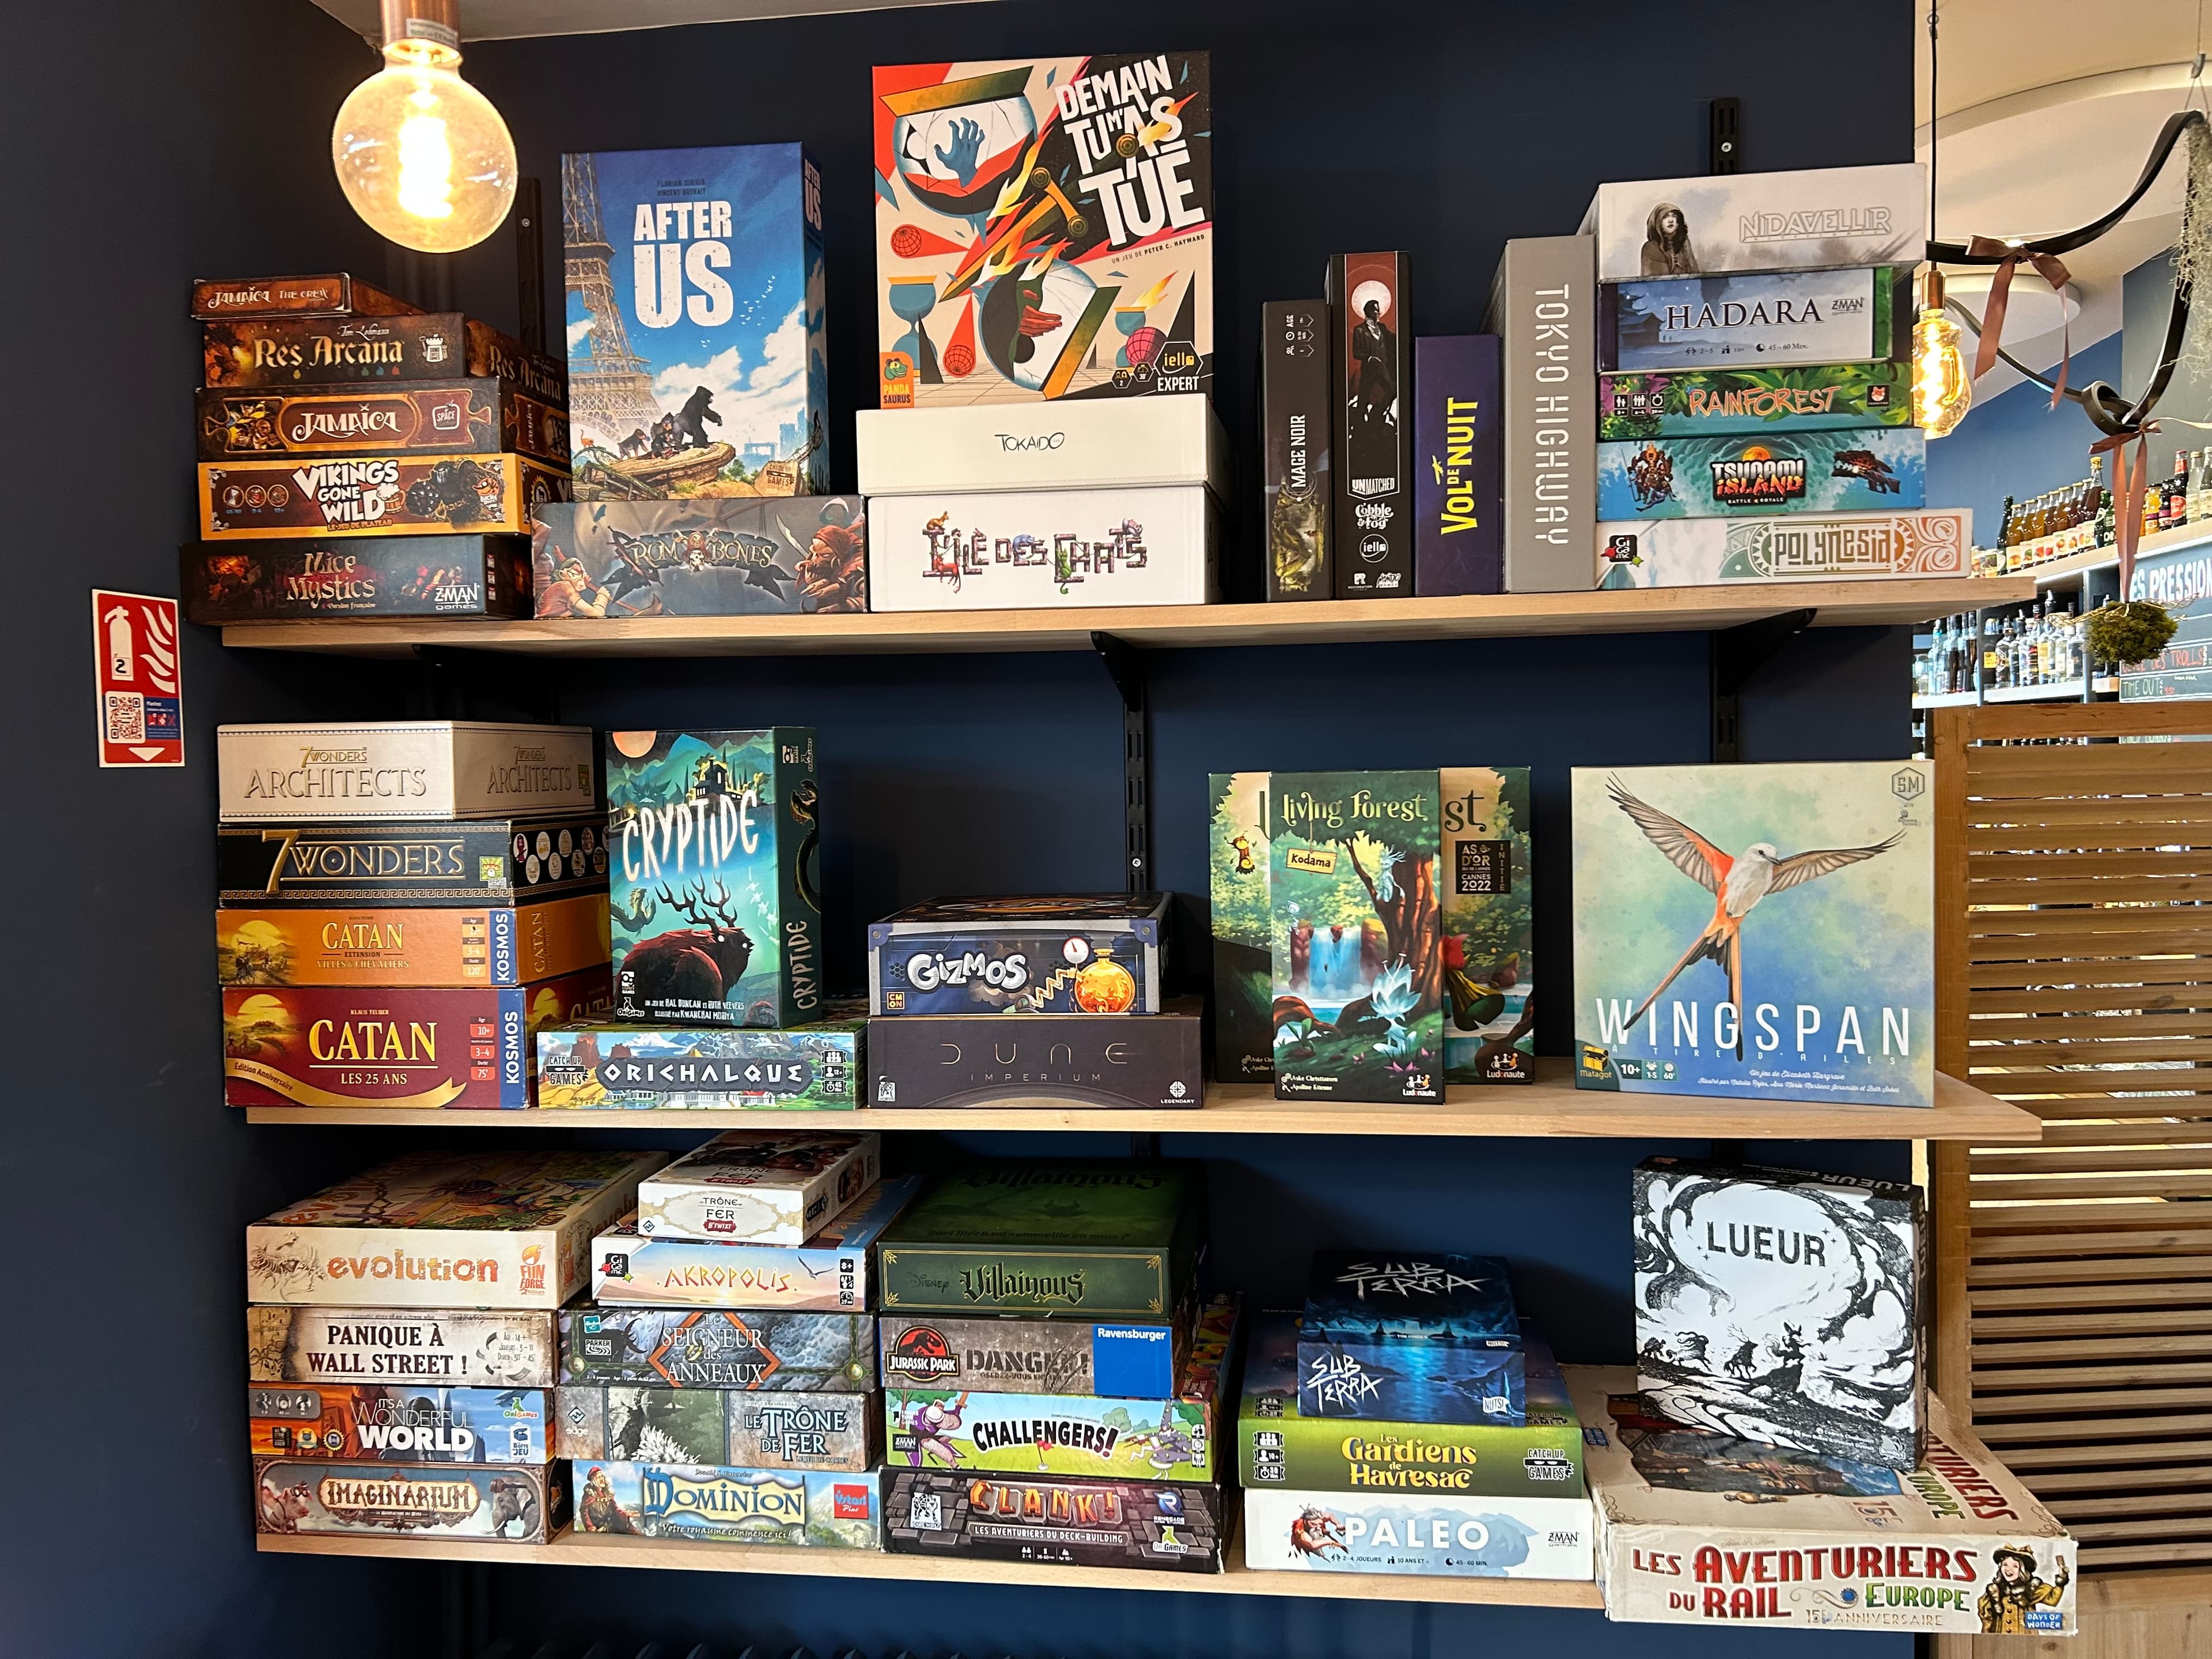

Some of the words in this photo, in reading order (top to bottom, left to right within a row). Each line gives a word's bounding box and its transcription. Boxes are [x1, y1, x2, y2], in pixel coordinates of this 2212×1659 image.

[1054, 55, 1173, 120] DEMAIN
[1063, 115, 1111, 175] TU
[805, 177, 821, 230] US
[1078, 139, 1205, 246] TUÉ
[634, 200, 732, 241] AFTER
[1739, 206, 1892, 243] NIDAVELLIR
[1143, 244, 1164, 255] PETER
[1174, 234, 1205, 247] HAYWARD
[279, 290, 298, 299] THE
[634, 240, 733, 328] US
[1665, 297, 1823, 331] HADARA
[1535, 284, 1569, 382] TOKYO
[254, 338, 302, 367] Res
[309, 335, 405, 366] Arcana
[1164, 352, 1194, 366] iello
[884, 383, 909, 395] PANDA
[1158, 376, 1199, 392] EXPERT
[884, 394, 910, 404] SAURUS
[1688, 385, 1842, 417] RAINFOREST
[994, 432, 1065, 452] TOKAIDO
[1290, 414, 1305, 446] NOIR
[1447, 397, 1478, 465] NUIT
[291, 460, 399, 501] VIKINGS
[1291, 449, 1306, 488] MAGE
[1447, 468, 1460, 485] DE
[1535, 396, 1569, 544] HIGHWAY
[317, 486, 361, 501] GONE
[1352, 477, 1395, 495] UNMATCHED
[321, 488, 385, 524] WILD
[1355, 503, 1393, 518] Cobble
[1441, 480, 1478, 535] VOL
[304, 551, 356, 577] Mice
[632, 541, 679, 567] RUM
[712, 538, 774, 568] BONES
[995, 539, 1048, 566] DES
[1054, 528, 1147, 584] CHATS
[286, 576, 375, 608] Mystics
[2170, 648, 2204, 667] TROLLS
[2142, 677, 2161, 695] OUT
[244, 767, 426, 798] ARCHITECTS
[486, 764, 572, 794] ARCHITECTS
[623, 790, 759, 882] CRYPTIDE
[1461, 844, 1477, 854] AS
[262, 830, 300, 895] 7
[289, 843, 465, 876] WONDERS
[1290, 853, 1331, 868] Kodama
[1461, 880, 1491, 891] 2022
[321, 922, 404, 949] CATAN
[496, 913, 510, 981] KOSMOS
[354, 960, 409, 969] CHEVALIERS
[785, 920, 818, 1010] CRYPTIDE
[678, 999, 701, 1009] DUNCAN
[478, 1027, 491, 1035] 10+
[1596, 998, 1910, 1056] WINGSPAN
[309, 1020, 438, 1062] CATAN
[504, 1011, 520, 1084] KOSMOS
[940, 1043, 1128, 1065] DUNE
[549, 1056, 571, 1065] CATCH
[604, 1063, 802, 1084] ORICHALQUE
[1620, 1064, 1641, 1075] 10+
[234, 1062, 257, 1078] Édition
[255, 1066, 294, 1092] Anniversaire
[340, 1073, 363, 1084] LES
[365, 1073, 379, 1084] 25
[382, 1074, 408, 1085] ANS
[550, 1074, 582, 1085] GAMES
[970, 1073, 1101, 1082] IMPERIUM
[1822, 1174, 1911, 1192] LUEUR
[706, 1209, 734, 1219] FER
[1707, 1220, 1825, 1267] LUEUR
[326, 1249, 498, 1282] evolution
[520, 1264, 546, 1278] FUN
[841, 1262, 853, 1270] 8+
[1347, 1262, 1445, 1279] SUB
[520, 1278, 546, 1290] FORGE
[960, 1263, 1086, 1305] Villainous
[1334, 1274, 1491, 1300] TERRA
[704, 1314, 720, 1325] Le
[327, 1325, 423, 1349] PANIQUE
[428, 1323, 444, 1347] À
[662, 1327, 765, 1349] SEIGNEUR
[1097, 1327, 1166, 1342] Ravensburger
[306, 1352, 366, 1374] WALL
[372, 1354, 453, 1375] STREET
[461, 1355, 468, 1375] !
[703, 1350, 722, 1360] des
[889, 1355, 928, 1370] JURASSIC
[929, 1357, 957, 1372] PARK
[1311, 1354, 1362, 1378] SUB
[665, 1363, 765, 1384] ANNEAUX
[1306, 1373, 1384, 1412] TERRA
[1484, 1399, 1504, 1410] NUTS!
[350, 1400, 474, 1429] WONDERFUL
[744, 1415, 762, 1429] LE
[760, 1405, 850, 1438] TRÔNE
[357, 1425, 474, 1451] WORLD
[760, 1438, 782, 1453] DE
[782, 1431, 831, 1461] FER
[972, 1420, 1119, 1459] CHALLENGERS!
[1342, 1437, 1478, 1465] Gardiens
[1380, 1434, 1398, 1444] Les
[1389, 1461, 1402, 1471] de
[1528, 1449, 1552, 1459] CATCH
[1553, 1449, 1565, 1459] UP
[1350, 1462, 1474, 1489] Havresac
[1528, 1468, 1565, 1480] GAMES
[326, 1480, 471, 1510] IMAGINARIUM
[645, 1467, 802, 1520] DOMINION
[970, 1480, 1115, 1524] CLANK!
[662, 1522, 685, 1533] Votre
[686, 1525, 727, 1539] royaume
[728, 1527, 773, 1538] commence
[975, 1525, 990, 1535] LES
[991, 1527, 1044, 1539] AVENTURIERS
[1046, 1530, 1057, 1539] DU
[1059, 1531, 1123, 1543] DECK-BUILDING
[1345, 1517, 1490, 1550] PALEO
[1632, 1548, 1681, 1576] LES
[1692, 1544, 1979, 1584] AVENTURIERS
[1669, 1590, 1696, 1612] DU
[1703, 1587, 1792, 1620] RAIL
[1865, 1582, 1971, 1612] EUROPE
[1833, 1612, 1943, 1627] ANNIVERSAIRE
[2027, 1613, 2047, 1622] DAYS
[2048, 1613, 2061, 1622] OF
